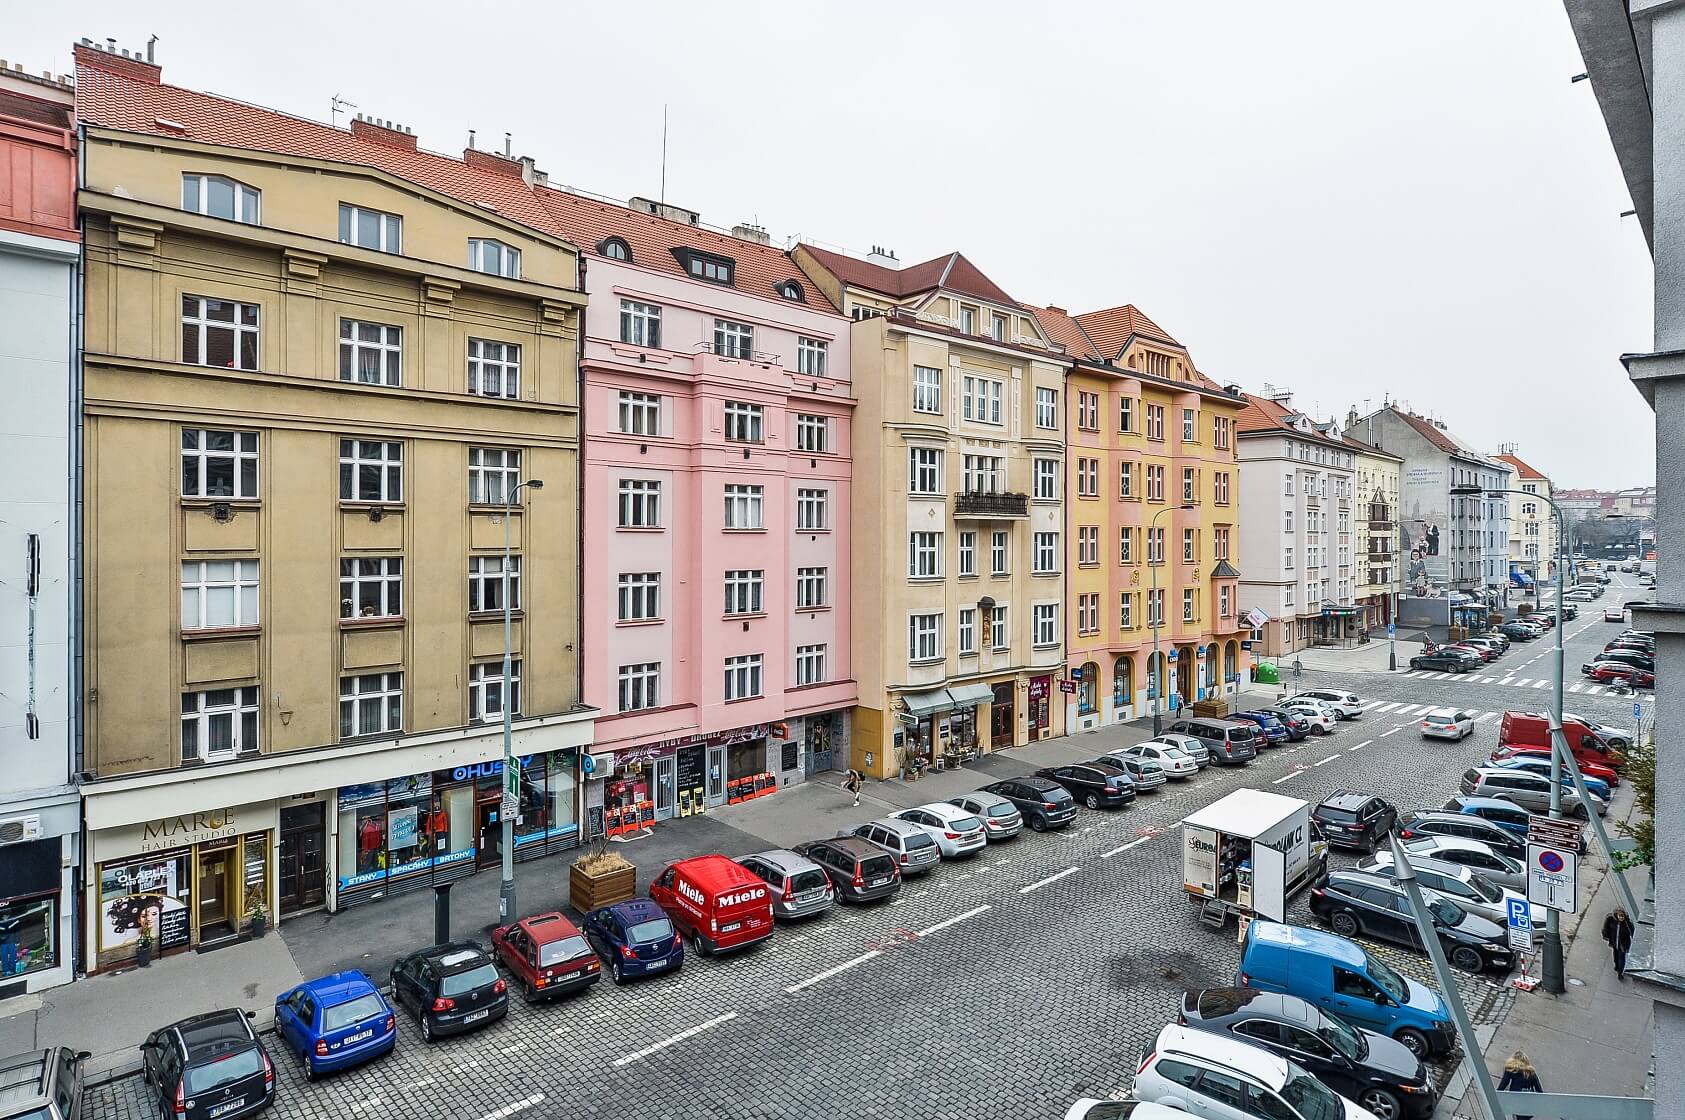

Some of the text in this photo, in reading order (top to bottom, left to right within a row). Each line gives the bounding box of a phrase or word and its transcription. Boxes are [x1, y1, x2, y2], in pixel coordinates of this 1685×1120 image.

[466, 754, 532, 779] HUSY
[142, 828, 236, 852] HAIR STUDIO
[439, 850, 471, 863] BATOHY
[348, 872, 378, 886] STANY
[678, 879, 705, 906] Miele
[718, 888, 766, 908] Miele
[1511, 901, 1525, 919] P
